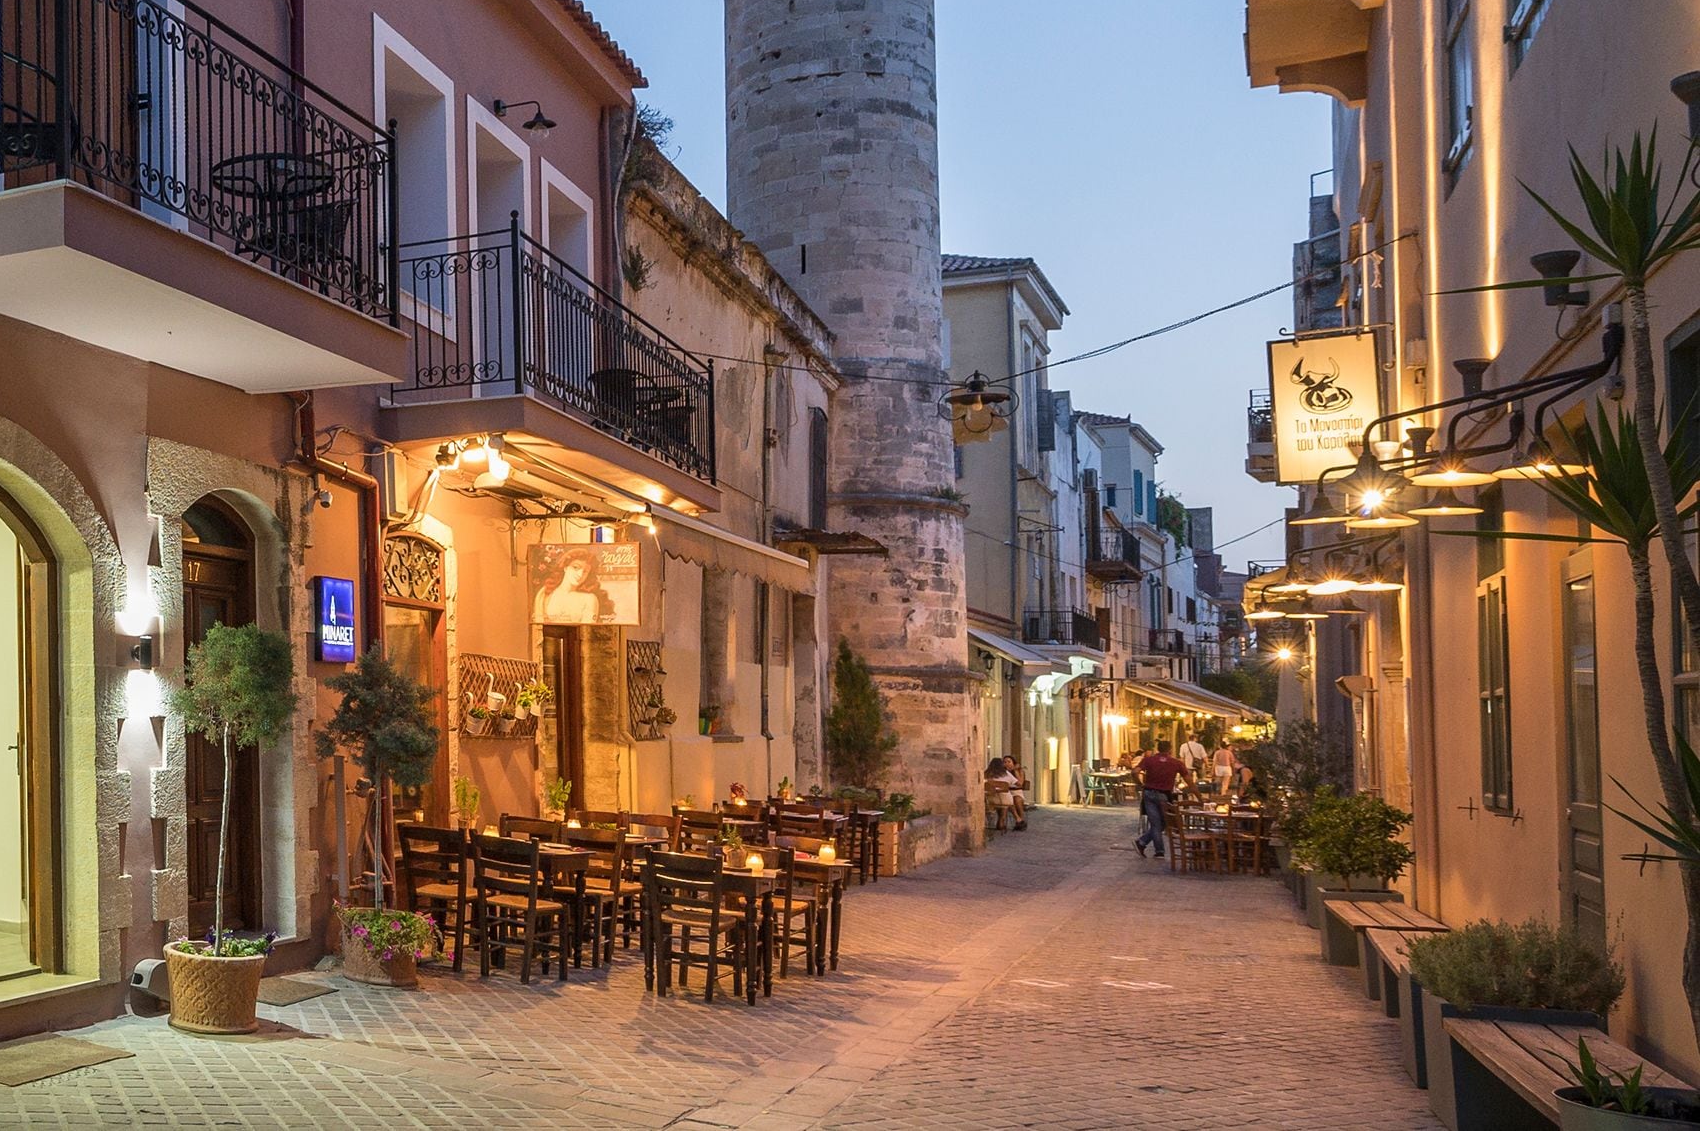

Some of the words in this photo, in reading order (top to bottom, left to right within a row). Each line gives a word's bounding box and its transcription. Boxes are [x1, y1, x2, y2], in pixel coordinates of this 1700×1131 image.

[1295, 419, 1307, 433] Το
[1309, 414, 1363, 432] Μοναστήρι
[1296, 438, 1314, 452] του
[187, 560, 201, 582] 17
[322, 624, 355, 642] MINARET
